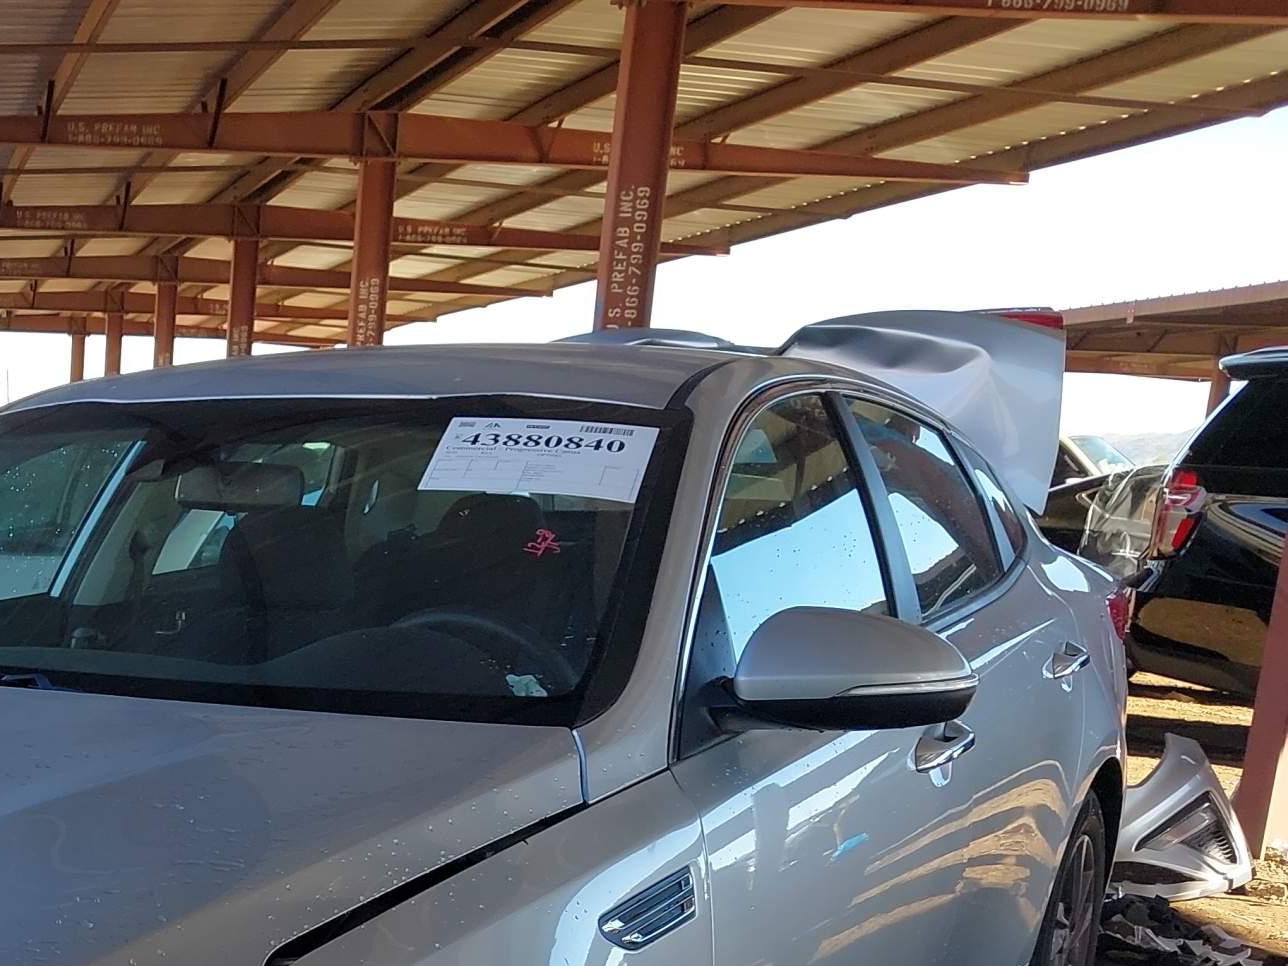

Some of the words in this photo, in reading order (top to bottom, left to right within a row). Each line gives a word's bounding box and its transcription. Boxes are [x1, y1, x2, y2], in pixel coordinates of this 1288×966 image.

[619, 184, 635, 217] INC.
[611, 226, 630, 292] PREFAB
[462, 433, 626, 453] 43880840
